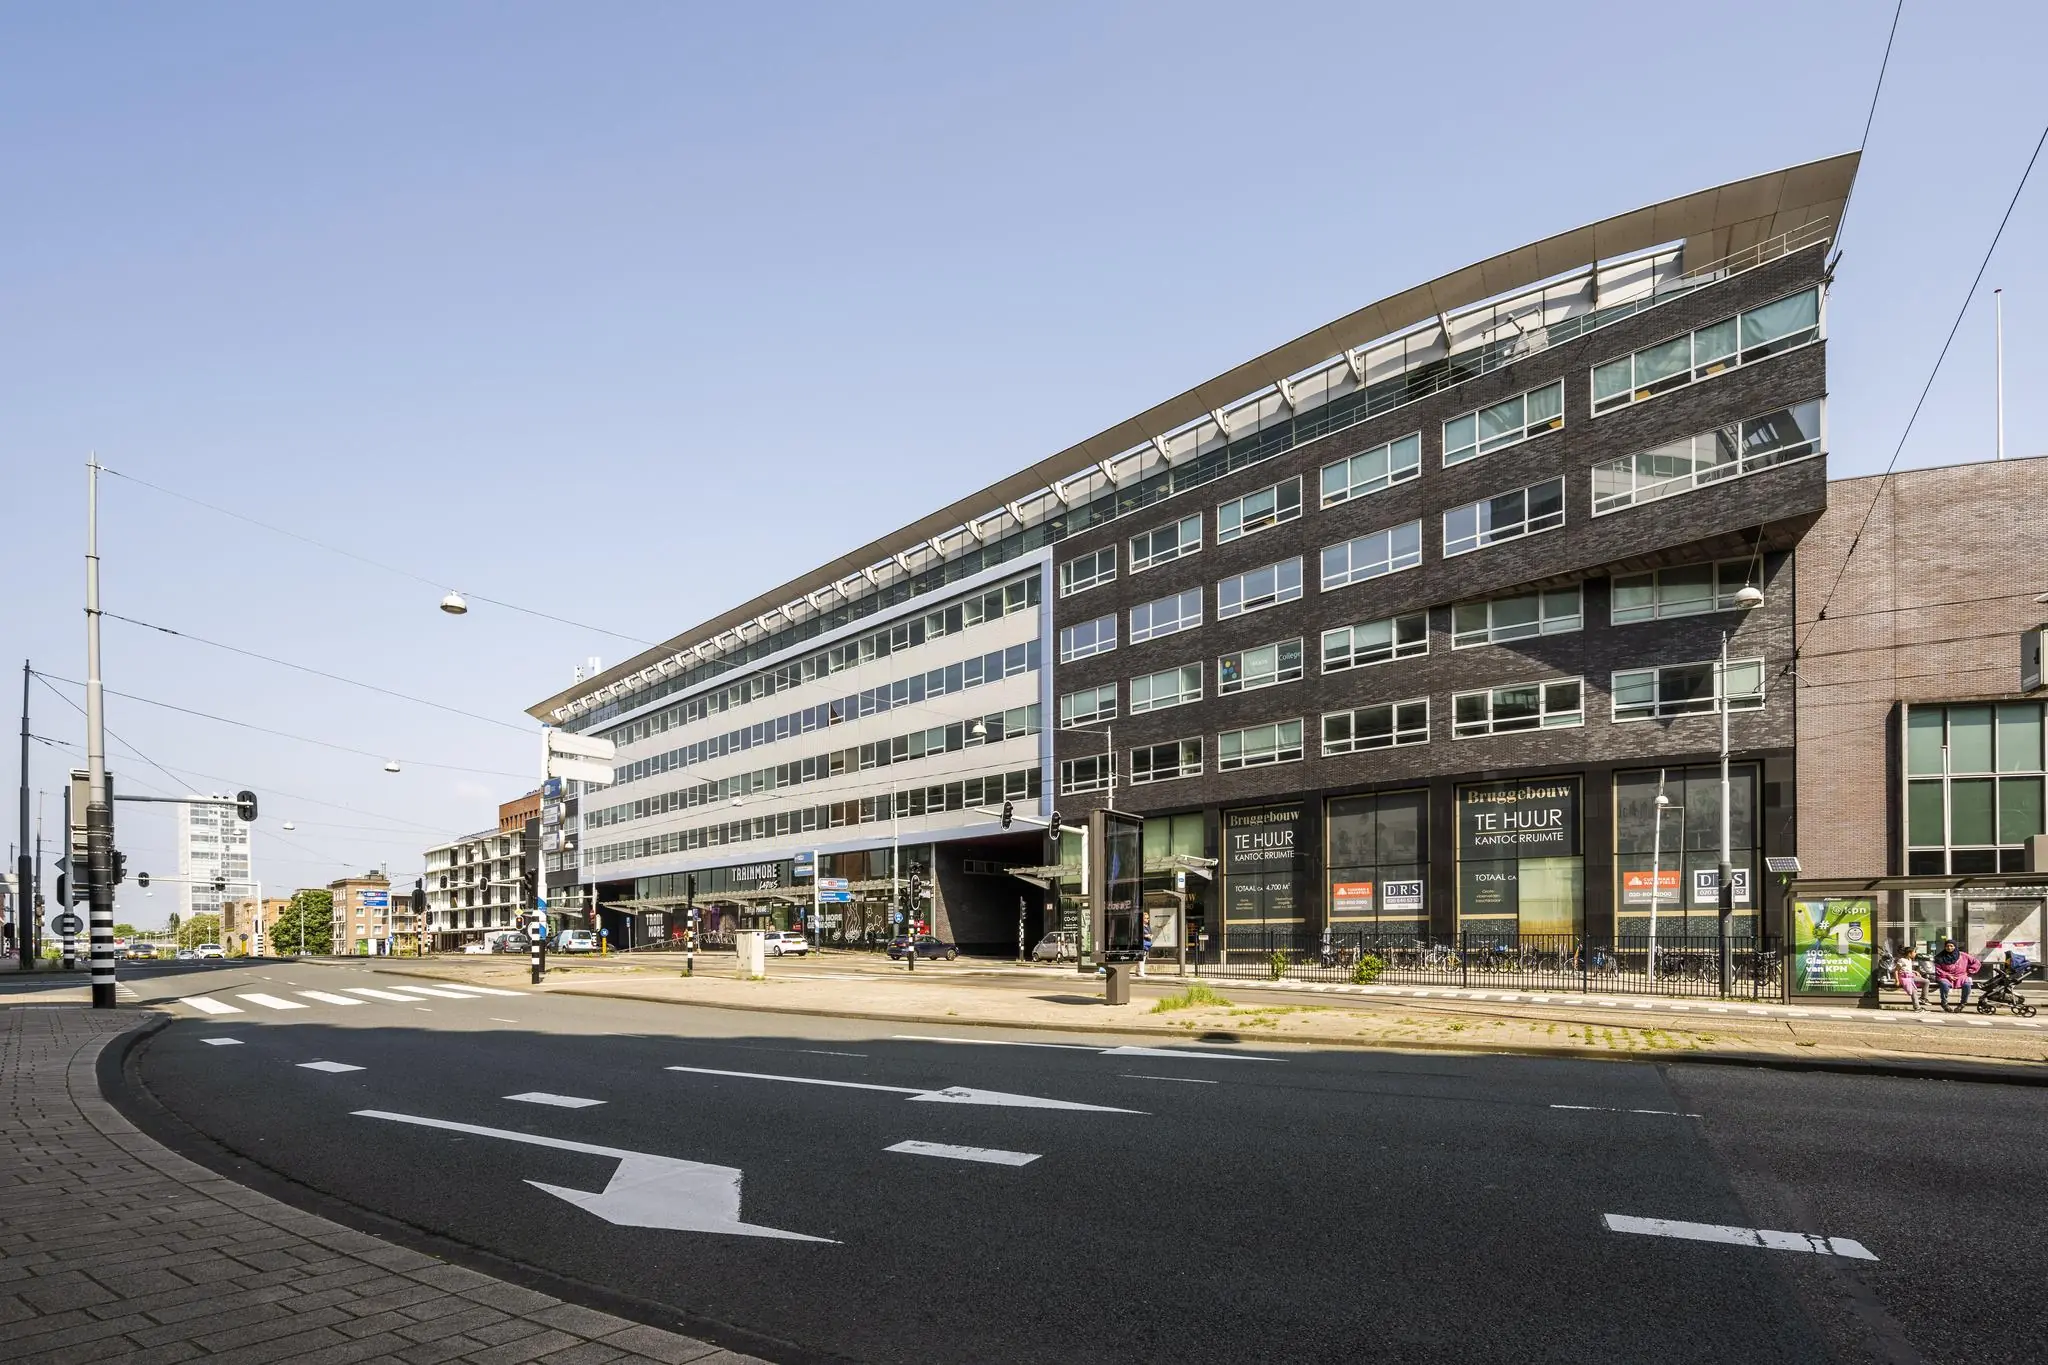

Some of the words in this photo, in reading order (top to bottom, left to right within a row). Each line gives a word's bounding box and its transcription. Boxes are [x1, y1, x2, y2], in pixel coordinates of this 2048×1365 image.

[1467, 786, 1570, 804] Bruggebouw
[1230, 811, 1300, 826] Bruggebouw
[1475, 813, 1496, 830] TE
[1503, 809, 1562, 828] HUUR
[1234, 834, 1249, 849] TE
[1254, 830, 1294, 847] HUUR
[1475, 873, 1506, 882] TOTAAL
[1844, 906, 1866, 915] kpn
[1806, 949, 1832, 957] 100%
[1805, 957, 1852, 965] Glasvezel
[1825, 965, 1848, 973] KPN
